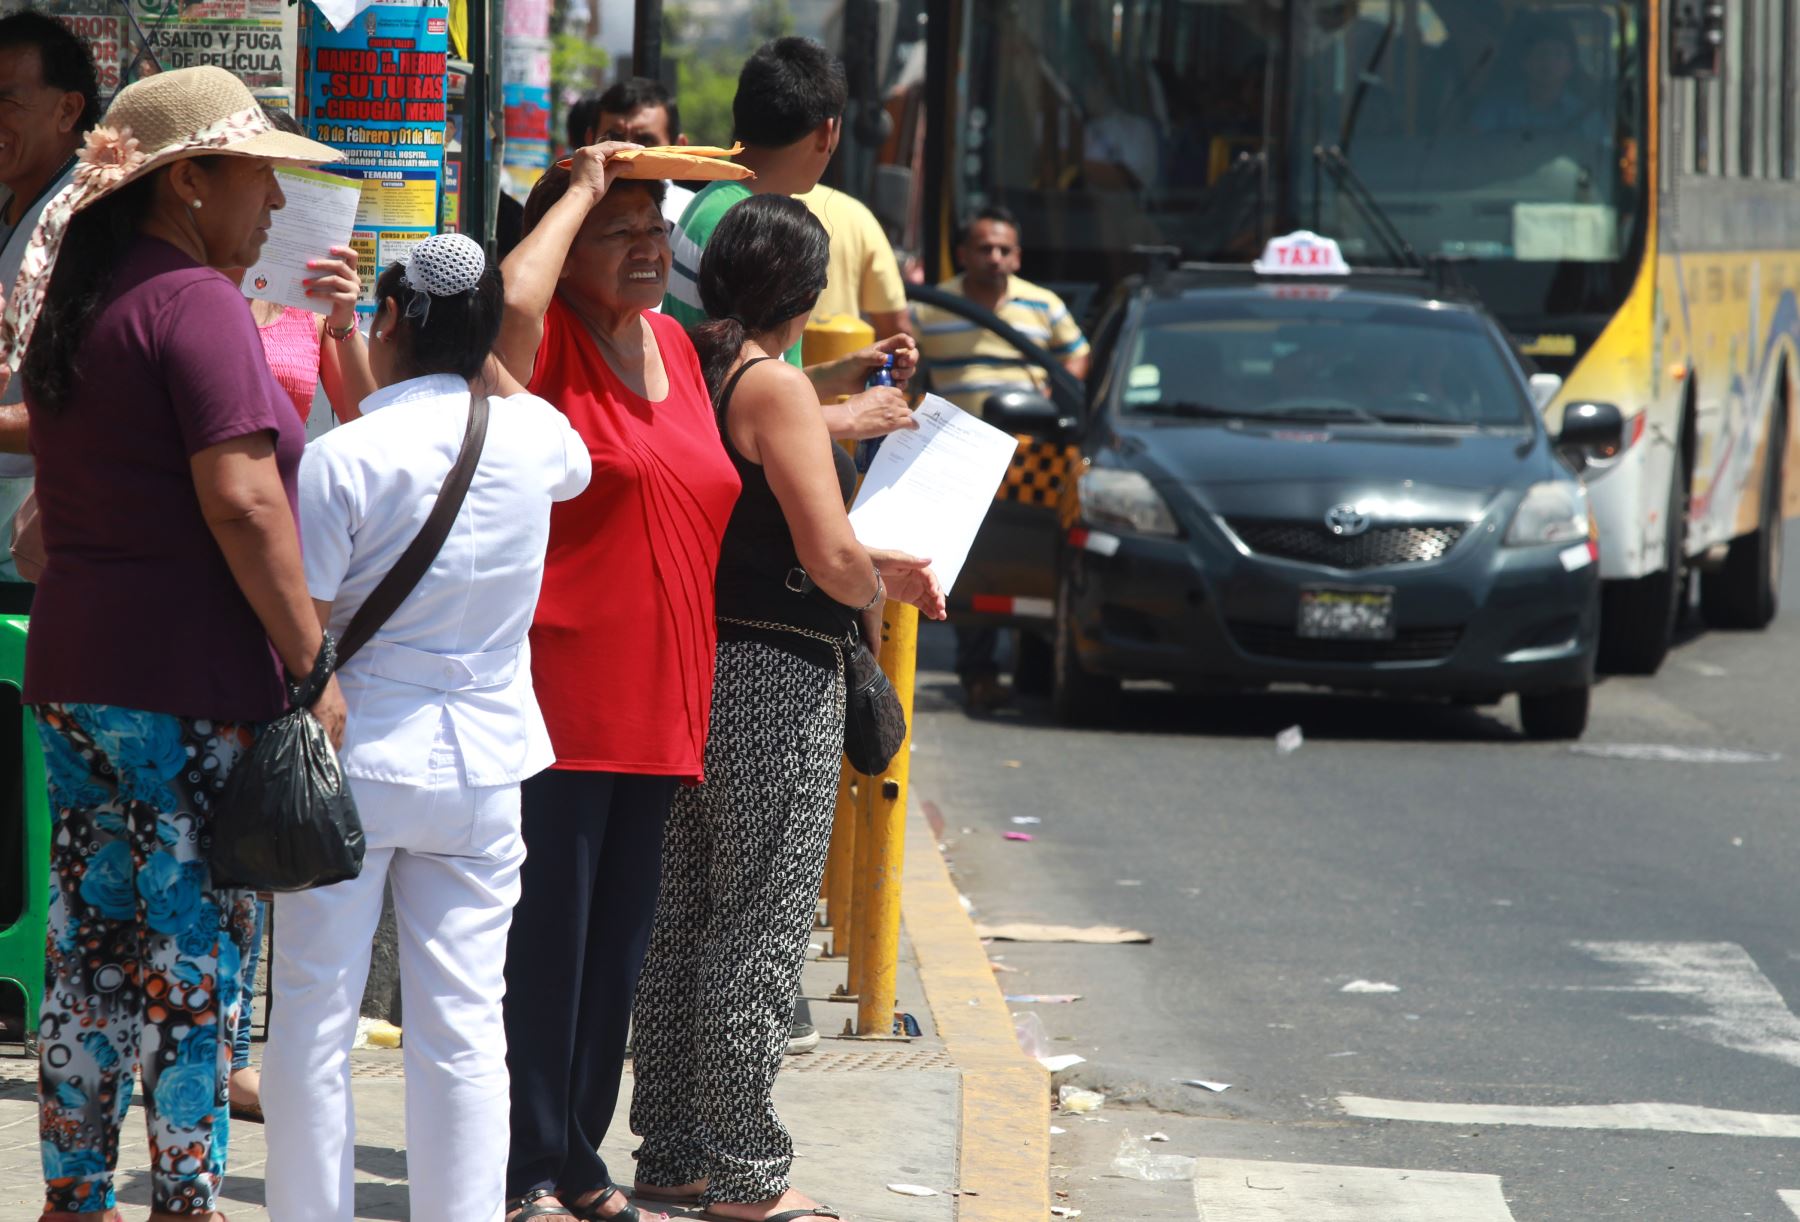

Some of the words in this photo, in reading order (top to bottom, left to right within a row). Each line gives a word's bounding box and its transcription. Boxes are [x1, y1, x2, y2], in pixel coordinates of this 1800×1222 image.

[149, 31, 212, 49] ASALTO
[219, 32, 230, 48] Y
[236, 33, 282, 50] FUGA
[172, 53, 192, 68] DE
[200, 50, 282, 71] PELÍCULA
[317, 50, 377, 73] MANEJO
[400, 53, 446, 74] HERIDAS
[331, 74, 443, 99] SUTURAS
[327, 99, 402, 120] CIRUGÍA
[318, 127, 329, 142] 28
[331, 127, 345, 143] de
[347, 127, 389, 144] Febrero
[391, 131, 397, 146] y
[400, 128, 411, 144] 01
[412, 129, 423, 144] de
[399, 151, 426, 159] HOSPITAL
[363, 170, 402, 179] TEMARIO
[1277, 247, 1330, 265] TAXI
